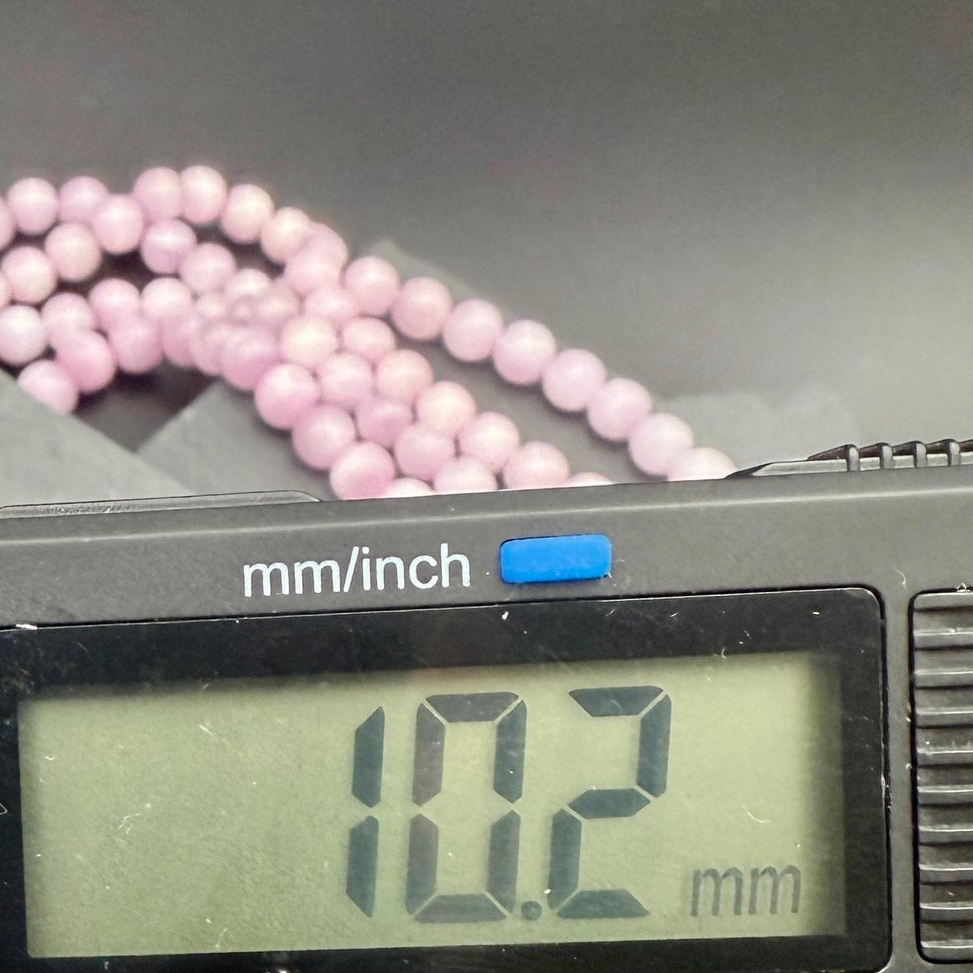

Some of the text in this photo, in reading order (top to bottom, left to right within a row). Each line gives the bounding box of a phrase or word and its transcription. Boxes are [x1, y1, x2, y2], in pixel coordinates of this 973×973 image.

[243, 543, 471, 597] mm/inch
[346, 685, 802, 924] 10.2 mm
